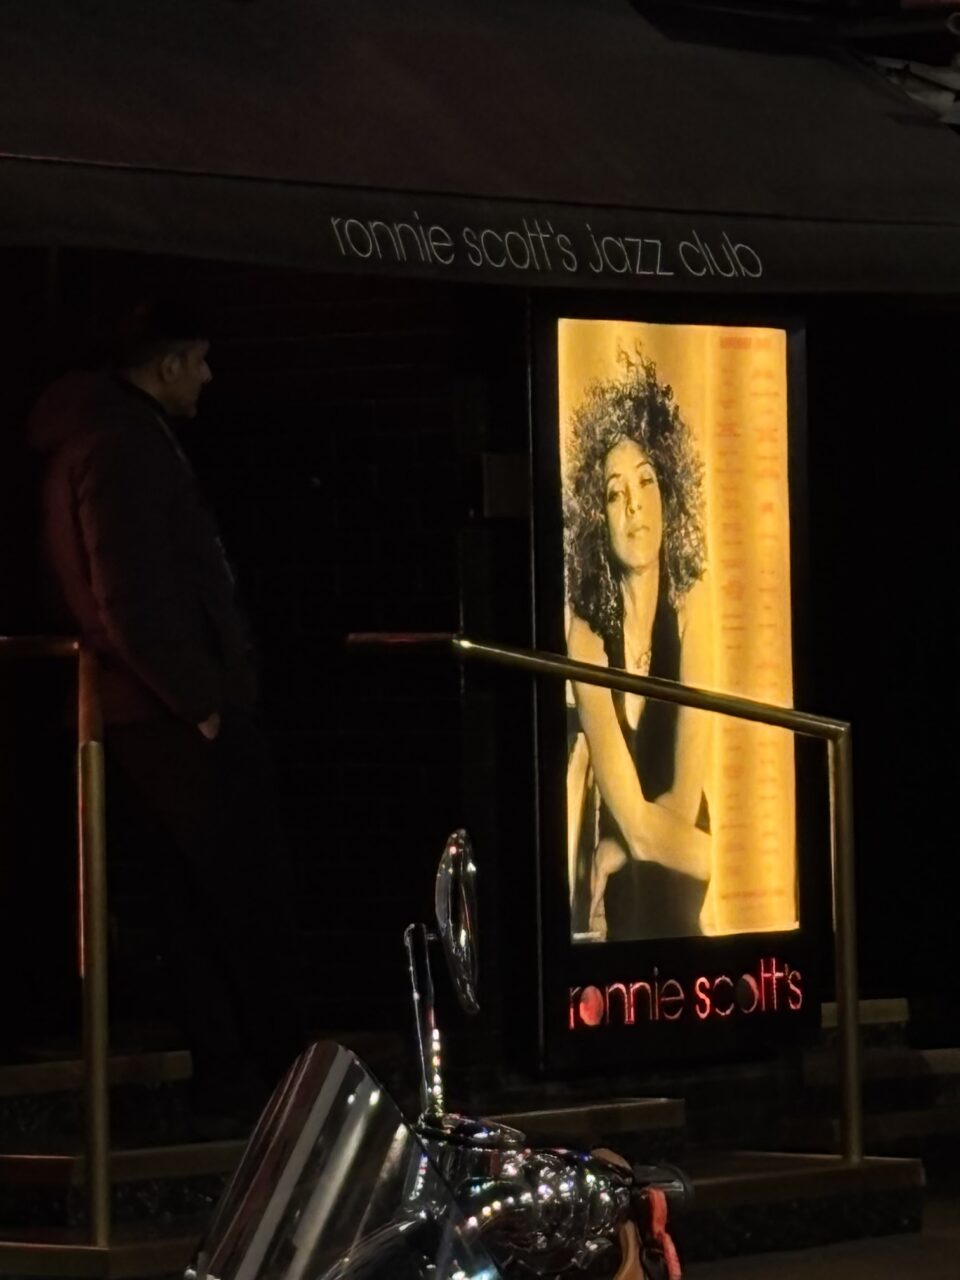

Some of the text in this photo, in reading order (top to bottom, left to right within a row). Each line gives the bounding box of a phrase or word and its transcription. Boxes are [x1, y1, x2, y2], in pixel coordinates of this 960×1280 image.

[330, 210, 763, 278] ronnie scott's jazz club
[567, 956, 803, 1031] ronnie scott's
